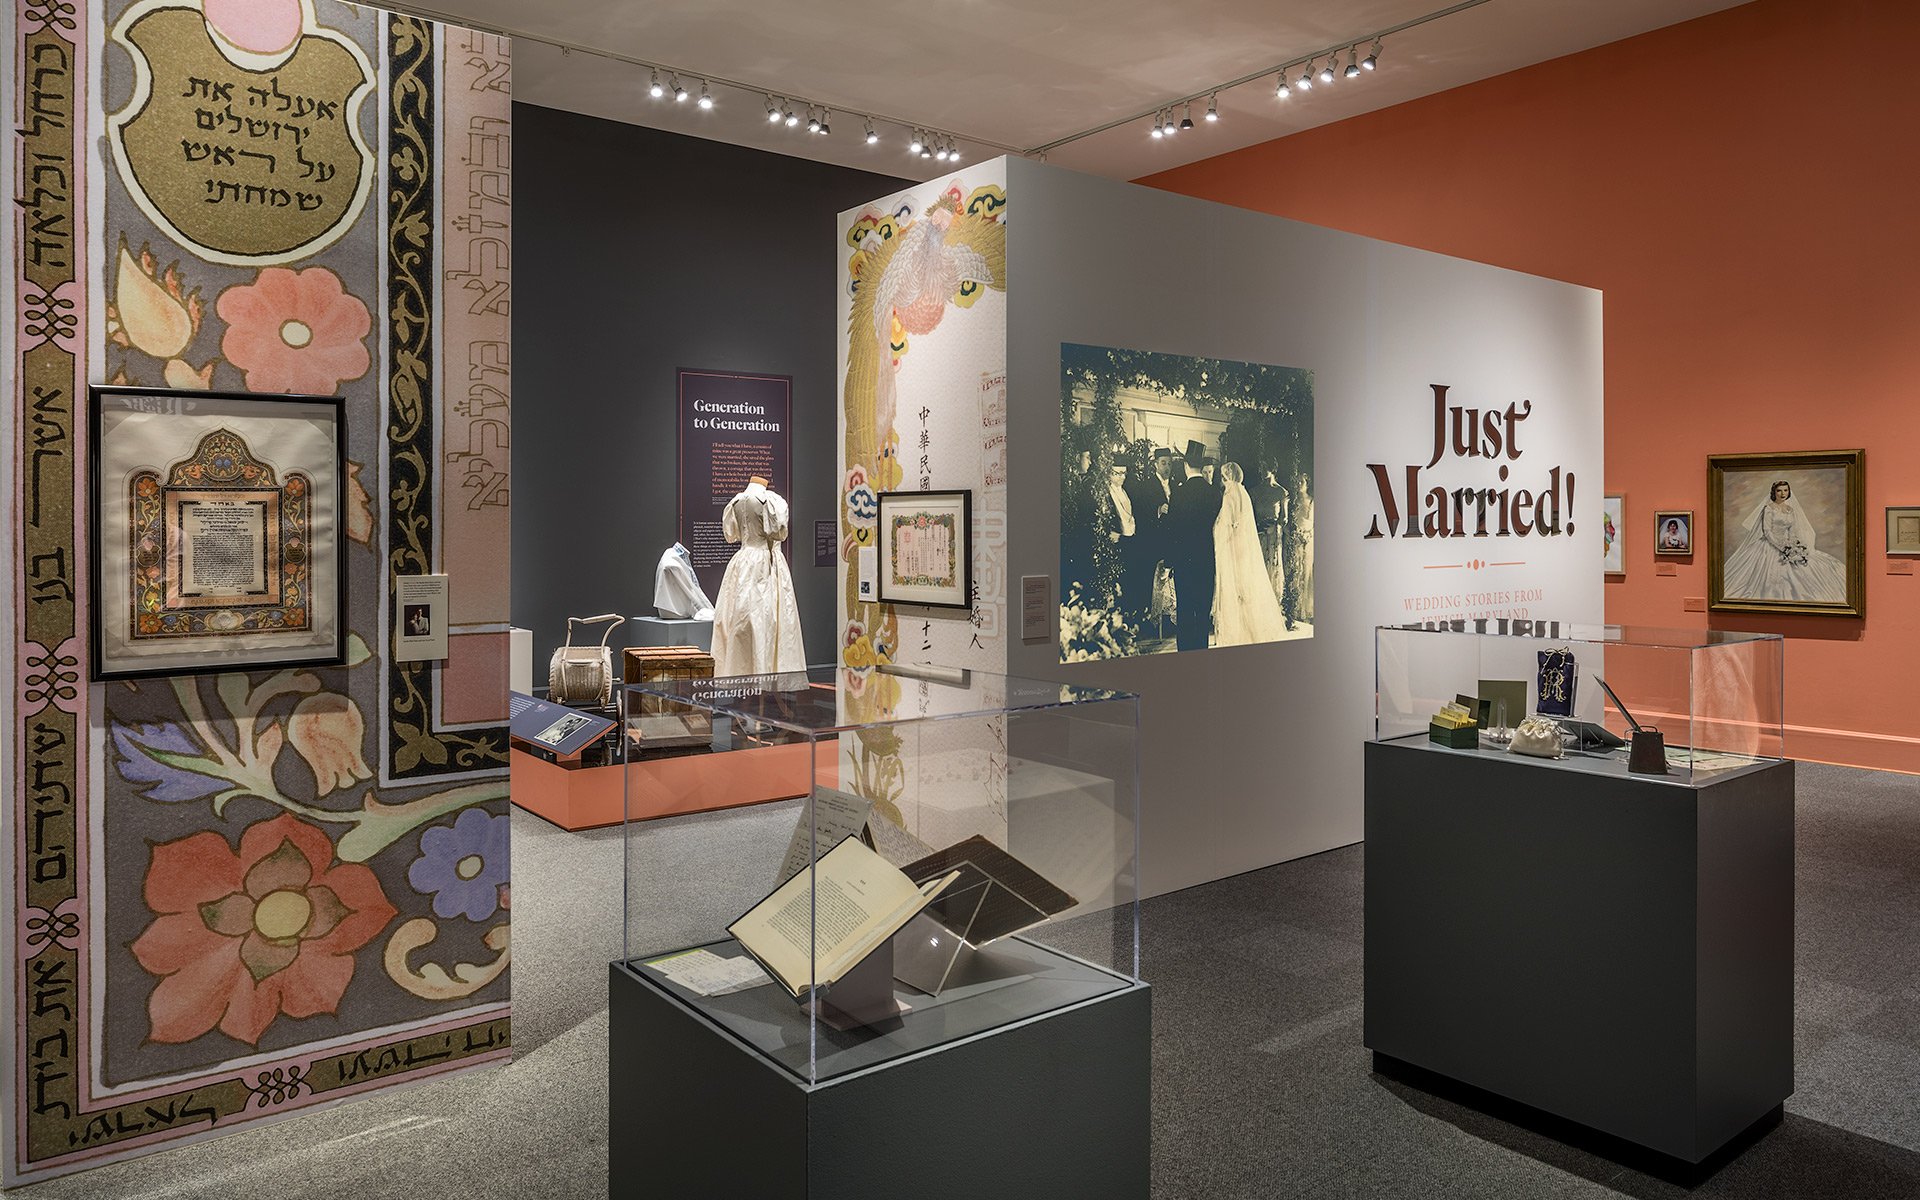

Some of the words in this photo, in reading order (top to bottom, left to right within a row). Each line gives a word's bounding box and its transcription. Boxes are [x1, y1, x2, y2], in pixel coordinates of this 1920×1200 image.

[14, 44, 68, 136] כרחל
[183, 76, 234, 103] את
[248, 78, 338, 121] אעלה
[195, 105, 311, 146] ירושלים
[182, 138, 277, 173] ראש
[297, 147, 337, 183] על
[12, 152, 68, 267] וכלאה
[204, 179, 324, 212] שמחתי
[694, 399, 765, 415] Generation
[694, 417, 708, 429] to
[710, 417, 780, 432] Generation
[1426, 383, 1532, 470] Just
[28, 386, 67, 528] אשר
[1364, 464, 1575, 539] Married!
[29, 547, 74, 605] בנו
[1404, 595, 1461, 611] WEDDING
[1465, 591, 1511, 607] STORIES
[1514, 589, 1543, 603] FROM
[32, 723, 70, 884] שתיהם
[32, 960, 72, 1022] את
[462, 1026, 511, 1052] חי
[32, 1028, 71, 1120] בית
[69, 1093, 218, 1146] ישראל
